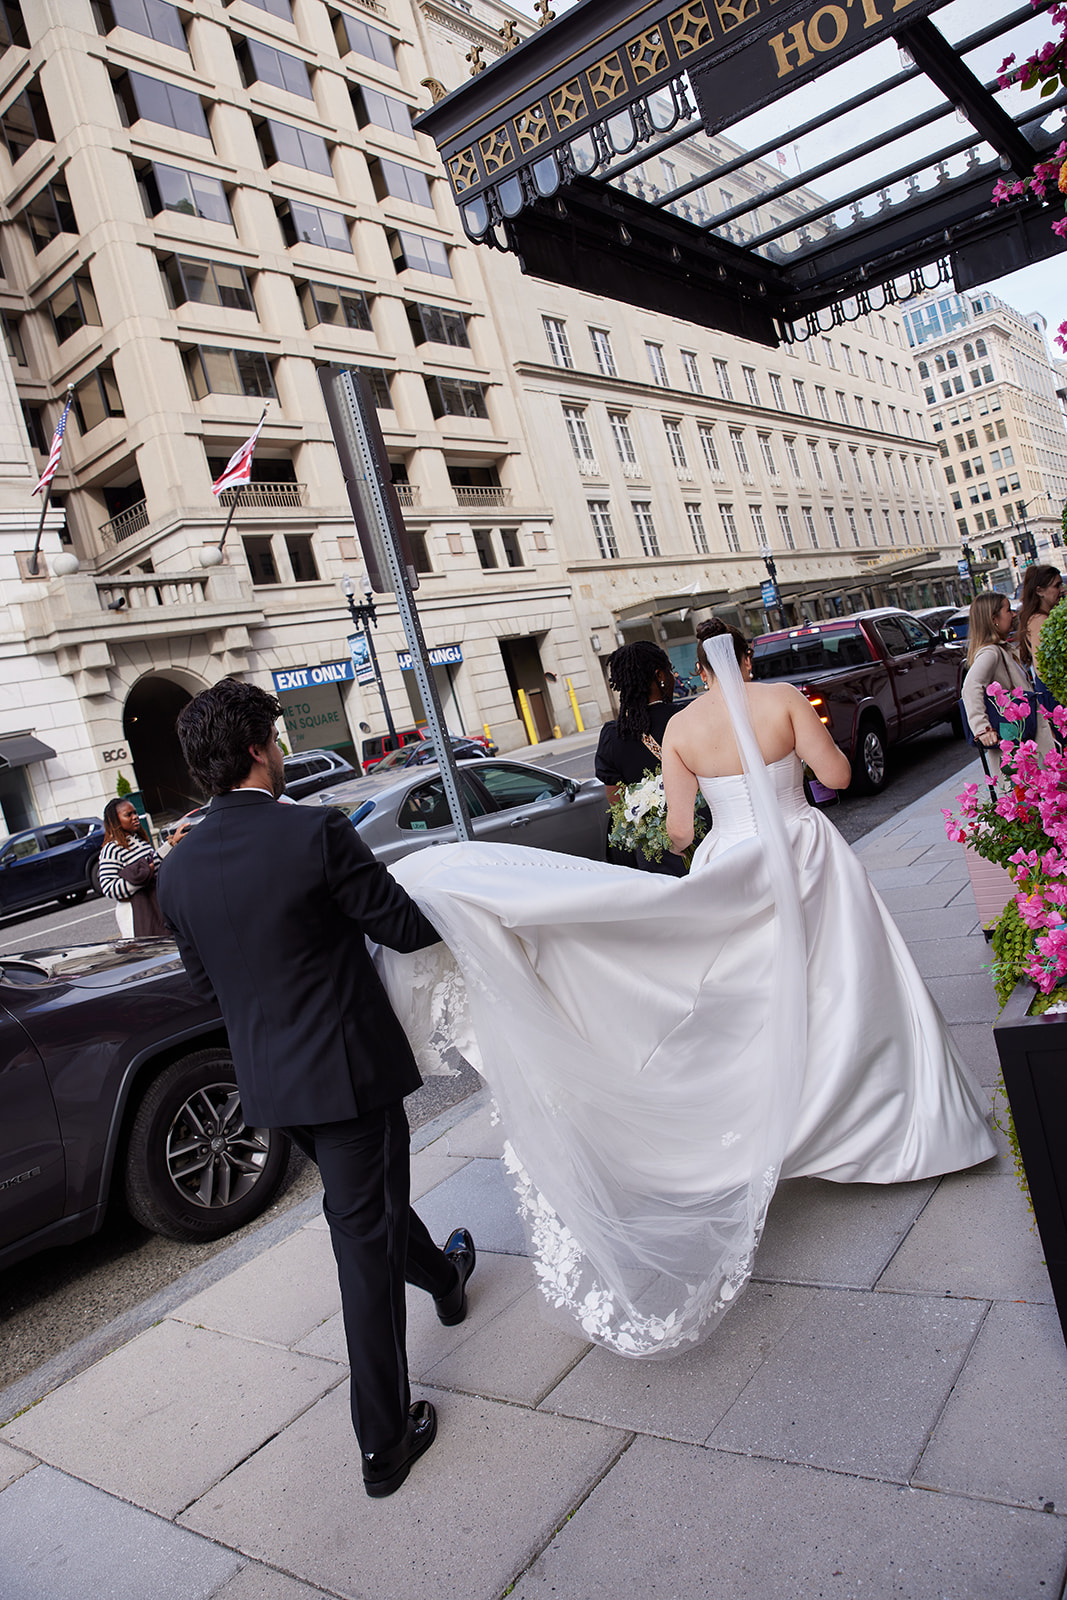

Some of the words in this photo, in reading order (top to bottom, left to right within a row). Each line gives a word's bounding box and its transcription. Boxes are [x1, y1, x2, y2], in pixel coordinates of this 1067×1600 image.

[768, 0, 917, 78] HOT
[403, 648, 455, 668] PKING
[276, 670, 308, 690] EXIT
[311, 664, 346, 683] ONLY
[295, 703, 310, 715] TO
[299, 711, 340, 729] SQUARE
[102, 748, 127, 762] BCG
